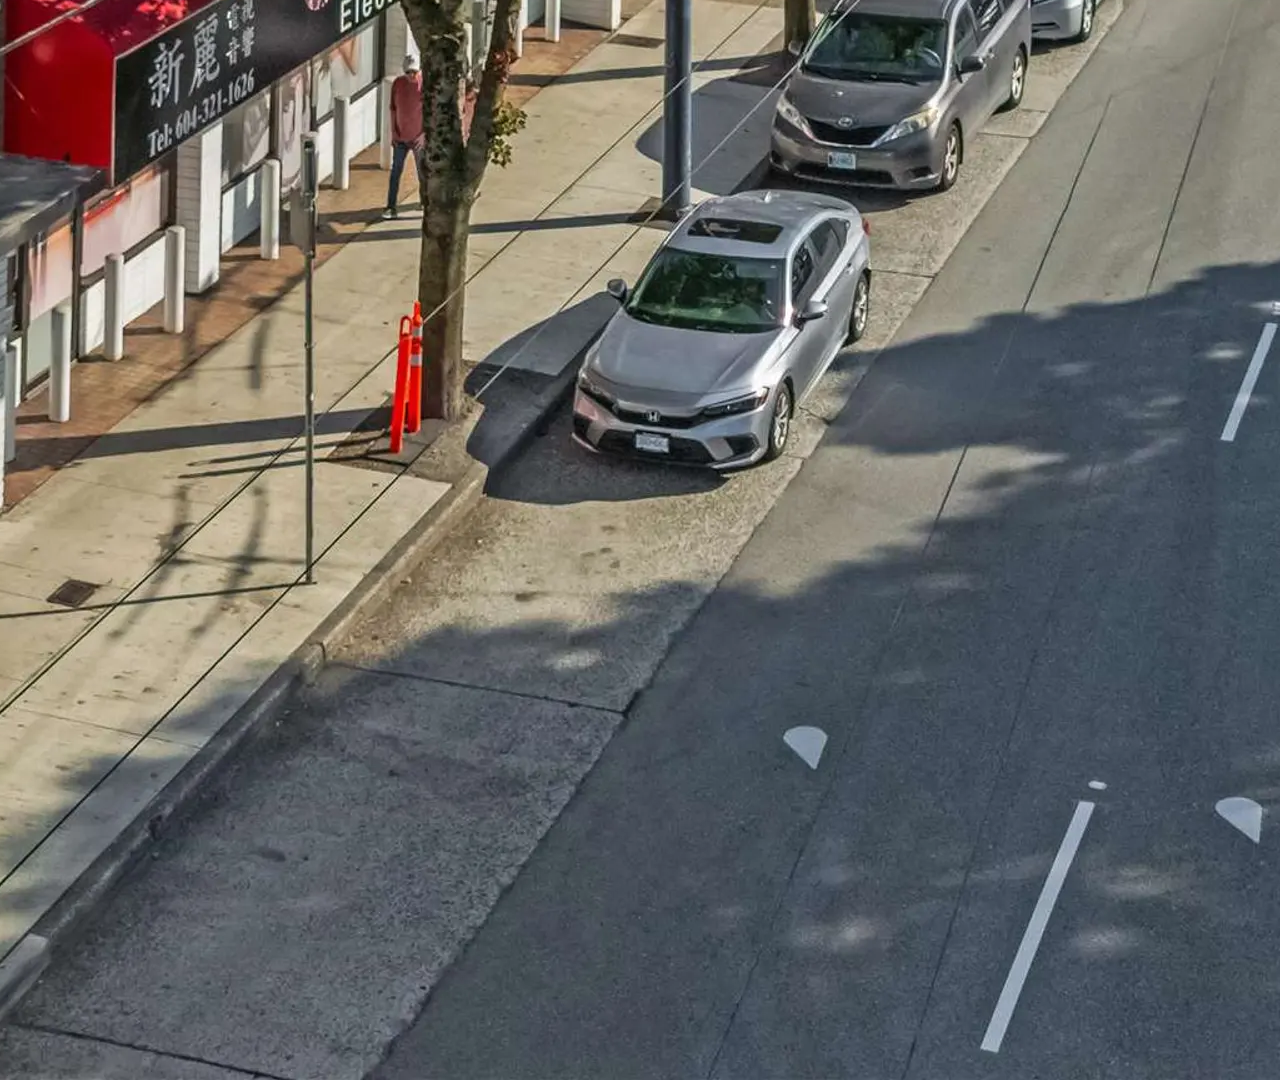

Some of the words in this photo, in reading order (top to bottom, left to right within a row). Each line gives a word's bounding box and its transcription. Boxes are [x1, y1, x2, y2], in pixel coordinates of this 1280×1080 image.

[148, 11, 221, 109] 新麗
[147, 122, 173, 158] Tel:
[175, 67, 255, 139] 604-321-1626
